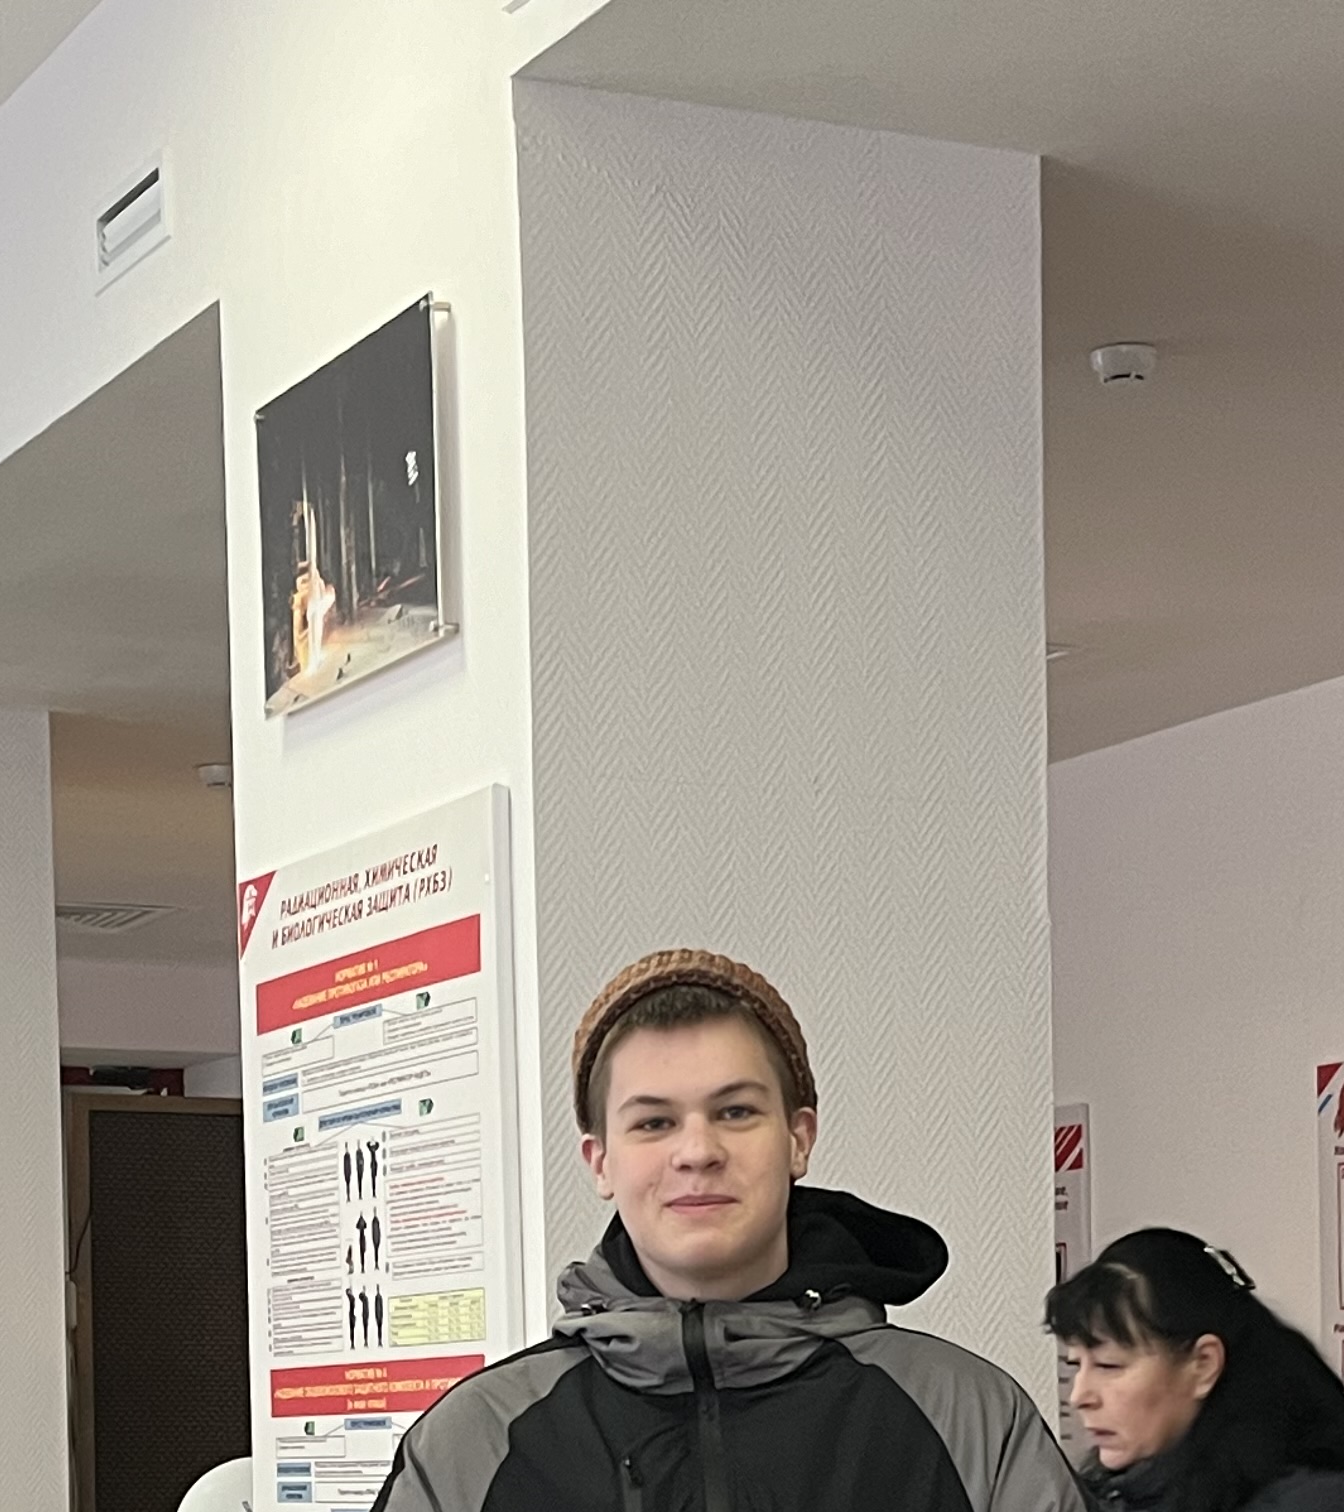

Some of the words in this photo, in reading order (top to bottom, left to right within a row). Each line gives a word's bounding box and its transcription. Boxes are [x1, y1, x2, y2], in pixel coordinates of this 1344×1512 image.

[364, 843, 438, 889] ХИМИЧЕСКАЯ
[271, 928, 279, 949] И
[281, 899, 364, 946] БИОЛОГИЧЕСКАЯ
[366, 883, 410, 917] ЗАЩИТА
[413, 865, 453, 903] (РХБЗ)
